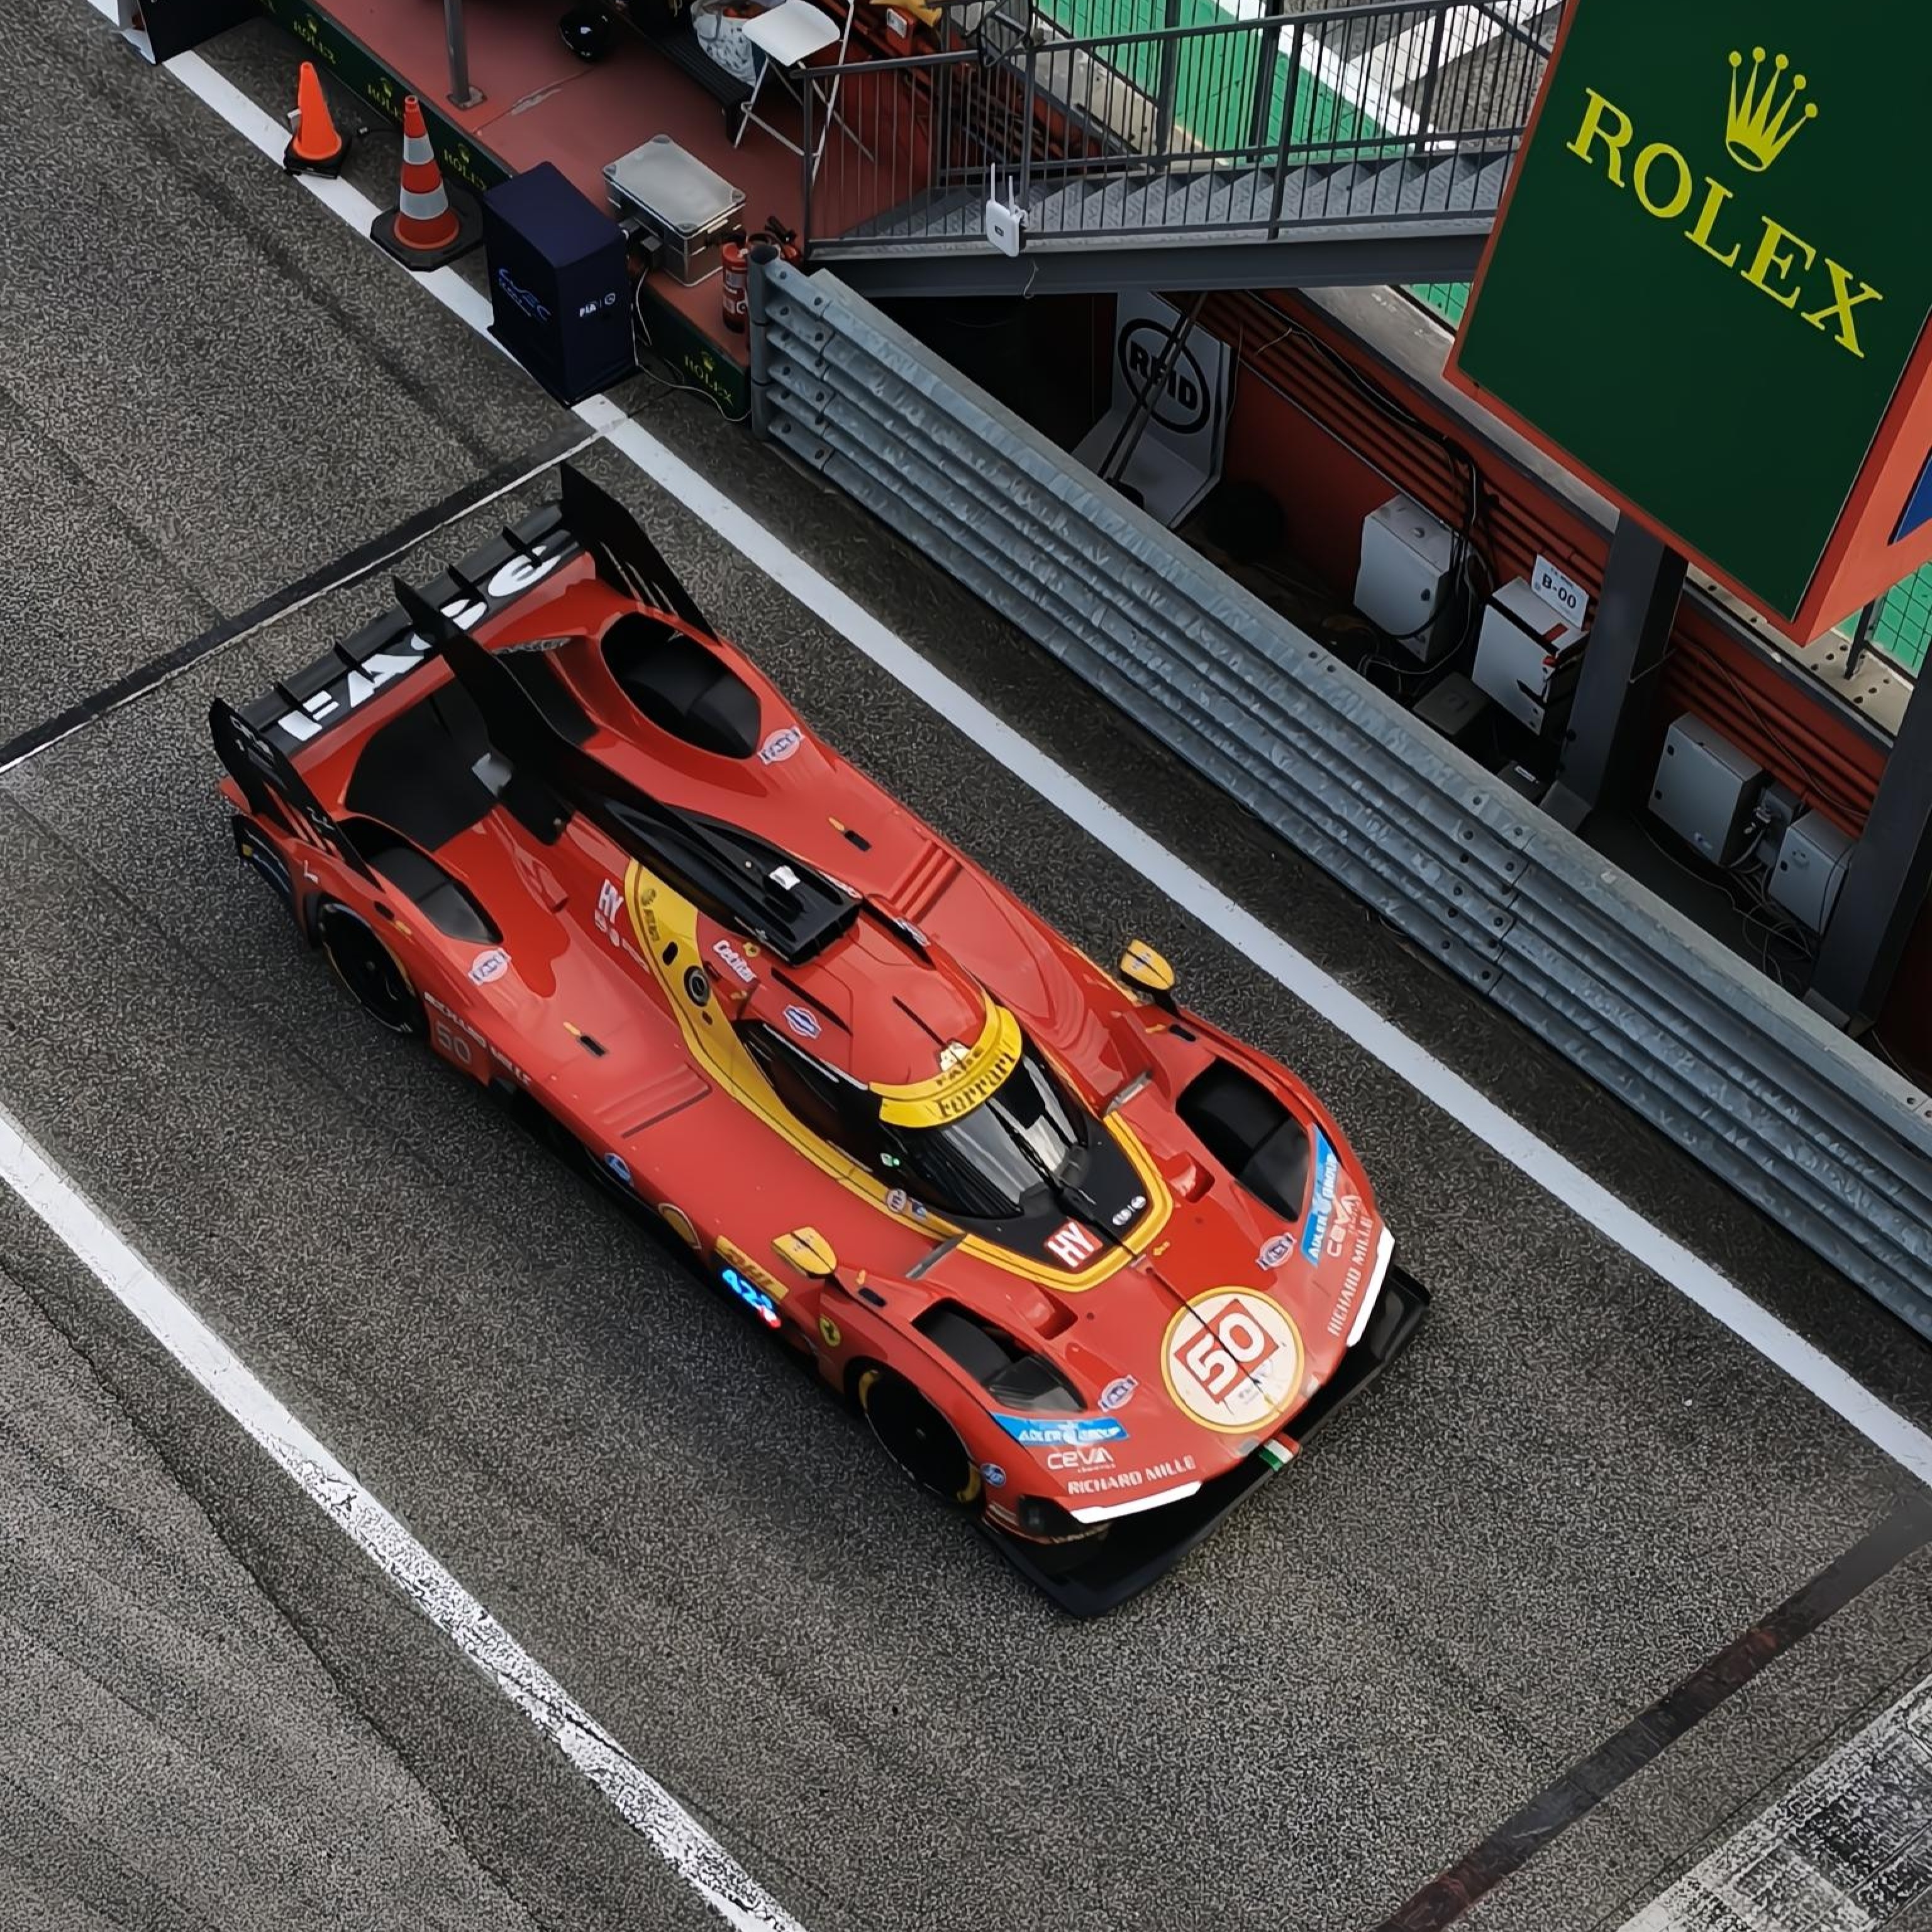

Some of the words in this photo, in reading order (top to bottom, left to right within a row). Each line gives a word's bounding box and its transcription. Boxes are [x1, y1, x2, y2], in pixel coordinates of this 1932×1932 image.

[1567, 87, 1883, 358] ROLEX
[1542, 572, 1577, 609] B-00
[436, 1020, 472, 1066] 50
[1046, 1221, 1095, 1268] HY
[1186, 1312, 1265, 1396] 50
[1068, 1470, 1143, 1495] RICHARD
